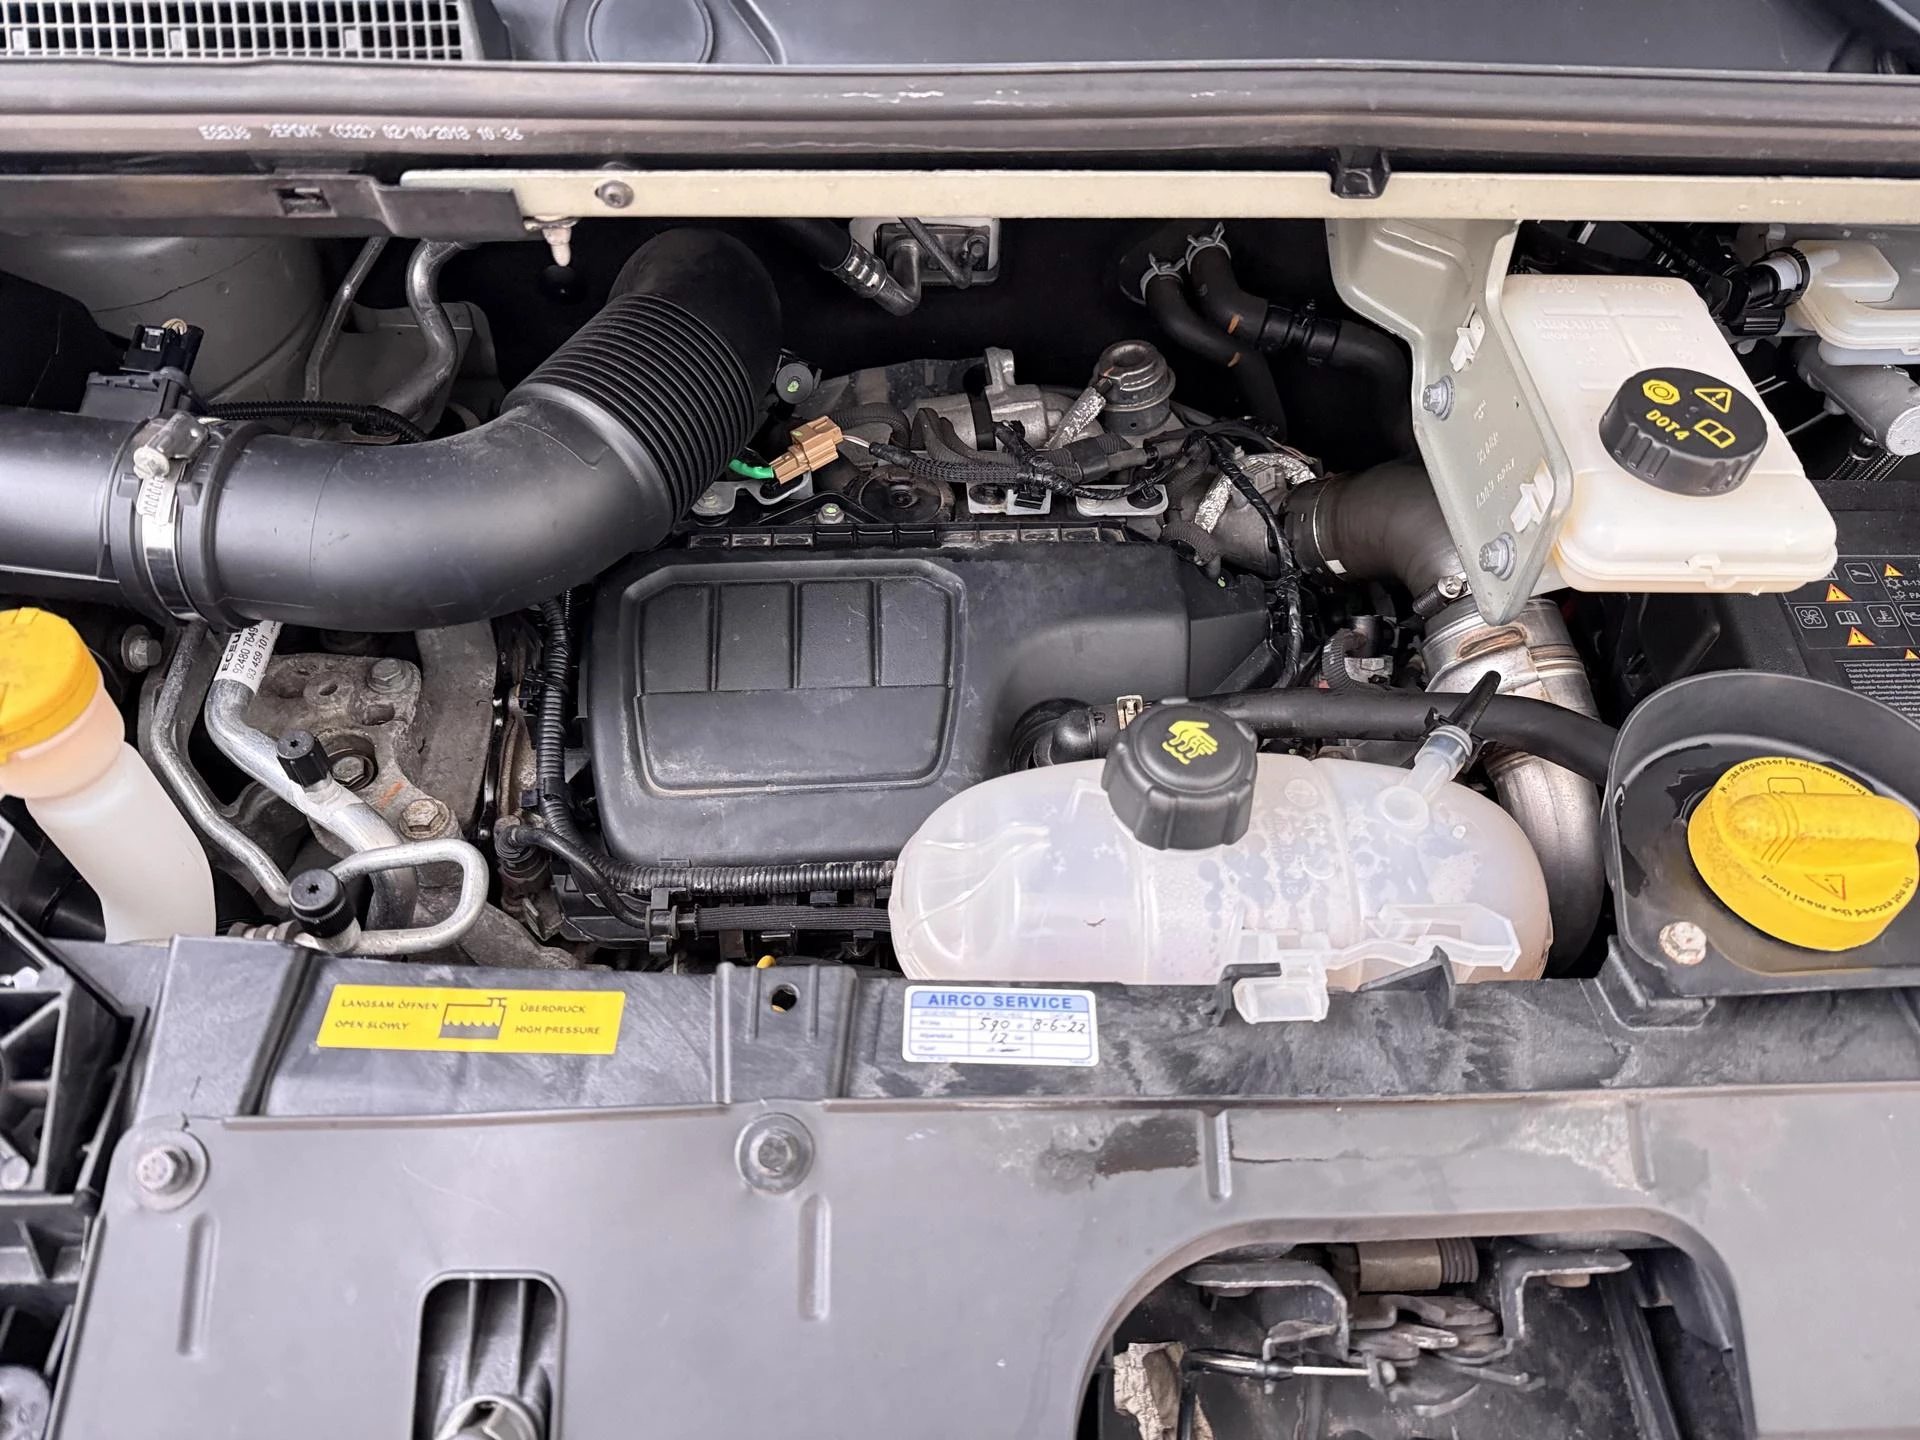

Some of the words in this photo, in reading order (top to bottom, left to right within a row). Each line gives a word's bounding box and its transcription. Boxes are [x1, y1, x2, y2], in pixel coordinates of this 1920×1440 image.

[341, 999, 395, 1010] LANGSAM
[928, 993, 986, 1007] AIRCO
[993, 995, 1073, 1009] SERVICE
[520, 1002, 587, 1014] ÜBERDRUCK
[335, 1019, 363, 1029] OPEN
[367, 1020, 410, 1031] SLOWLY
[514, 1024, 541, 1034] HIGH
[544, 1025, 600, 1036] PRESSURE
